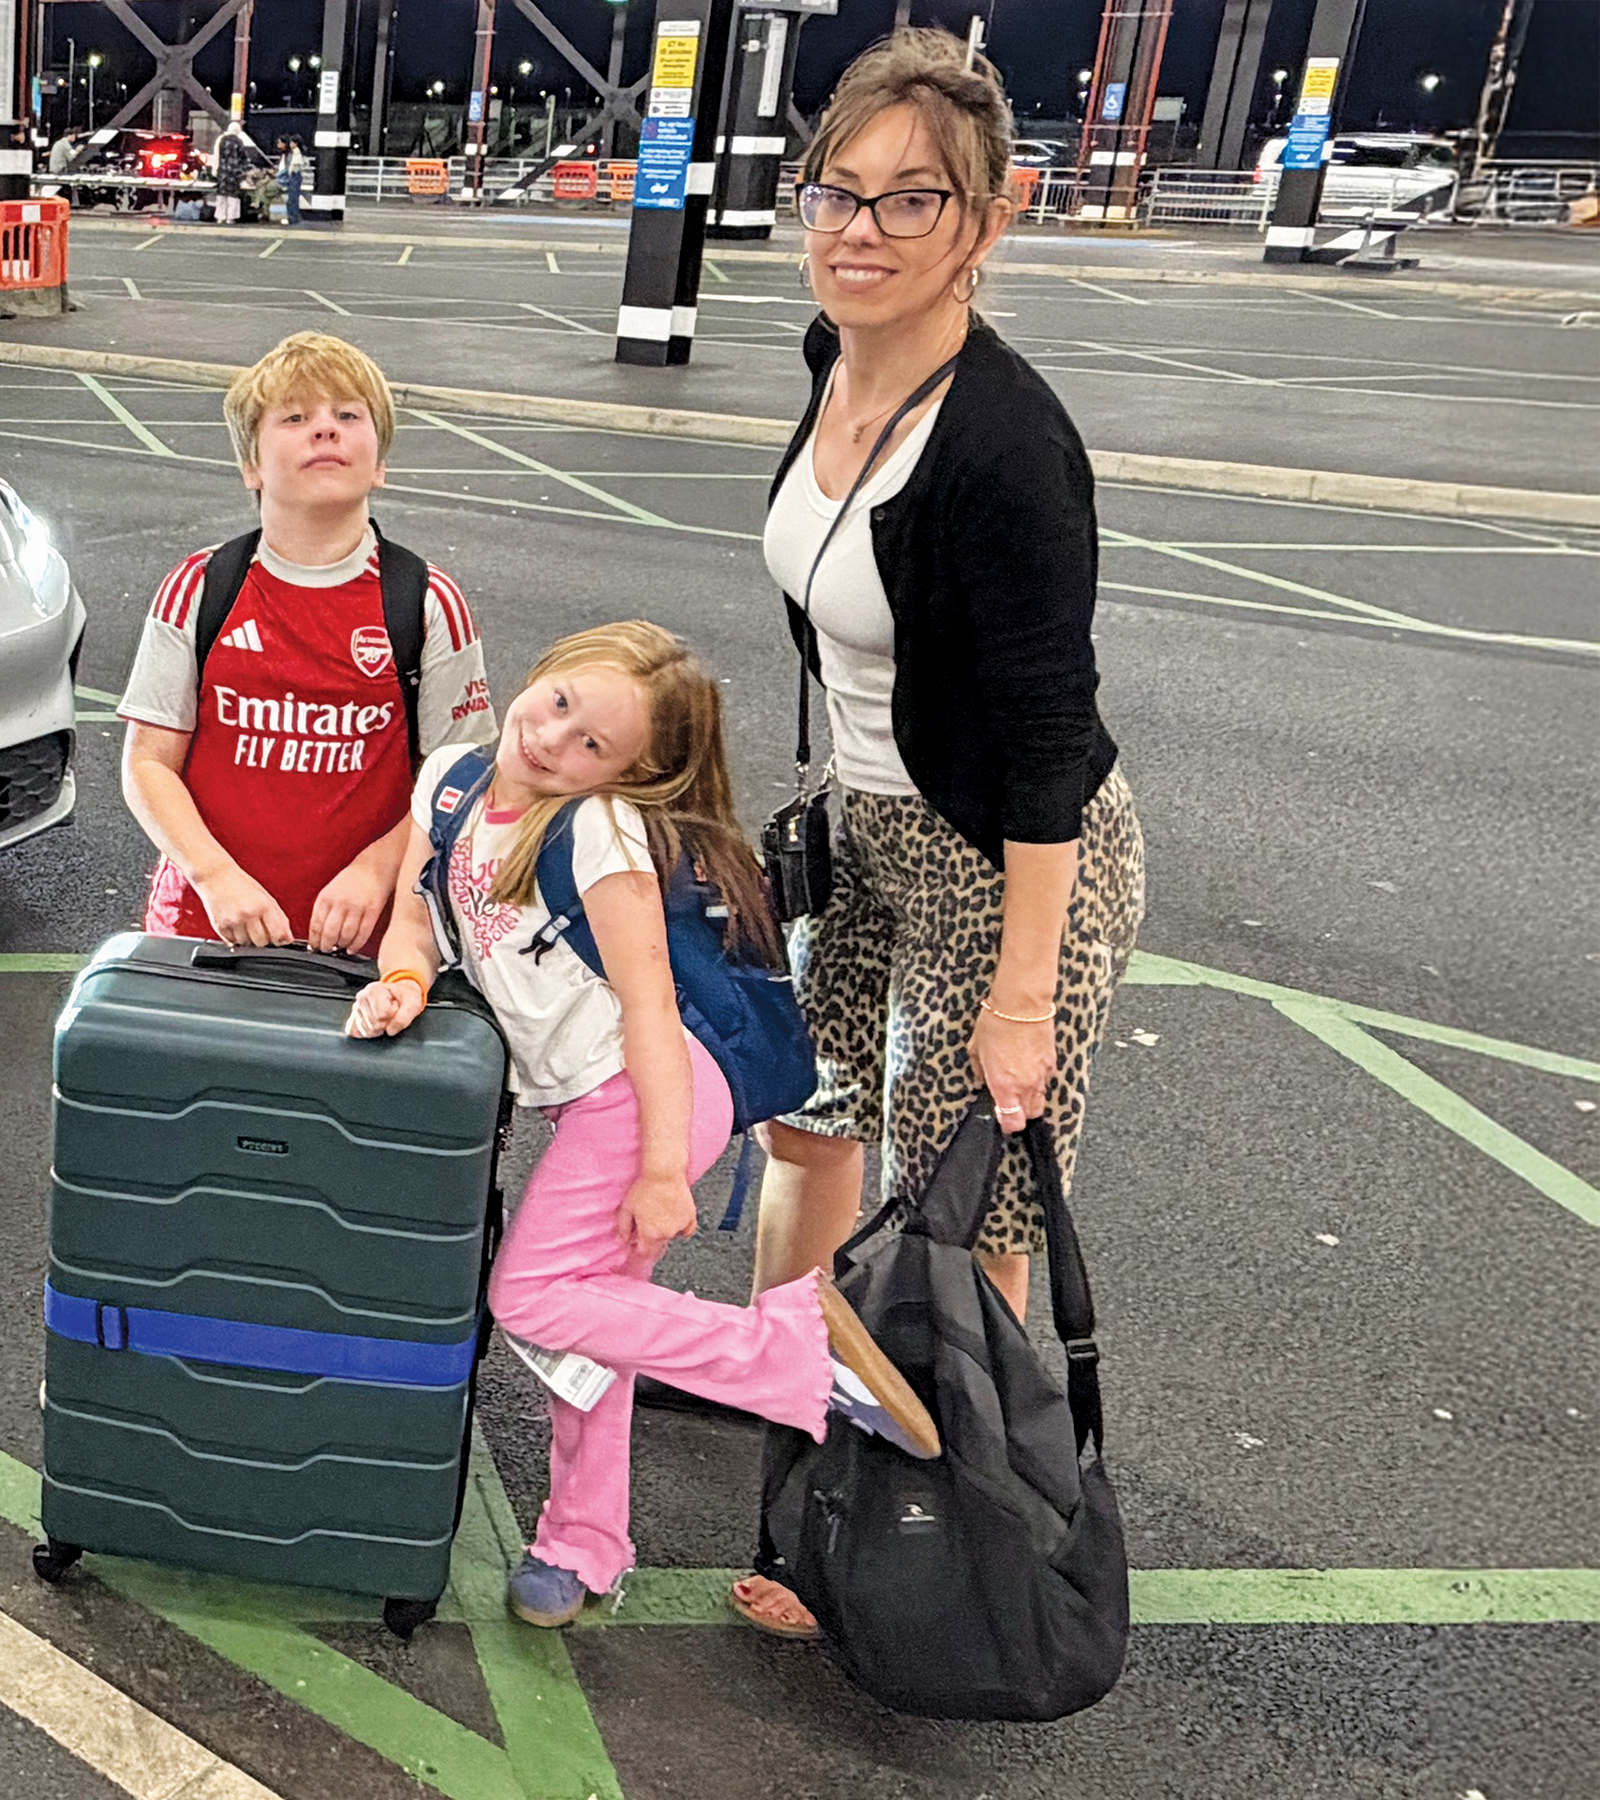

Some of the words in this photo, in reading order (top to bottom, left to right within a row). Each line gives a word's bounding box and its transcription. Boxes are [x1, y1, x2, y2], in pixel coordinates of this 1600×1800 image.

[212, 685, 395, 736] Emirates
[234, 734, 276, 769] FLY
[279, 738, 366, 774] BETTER
